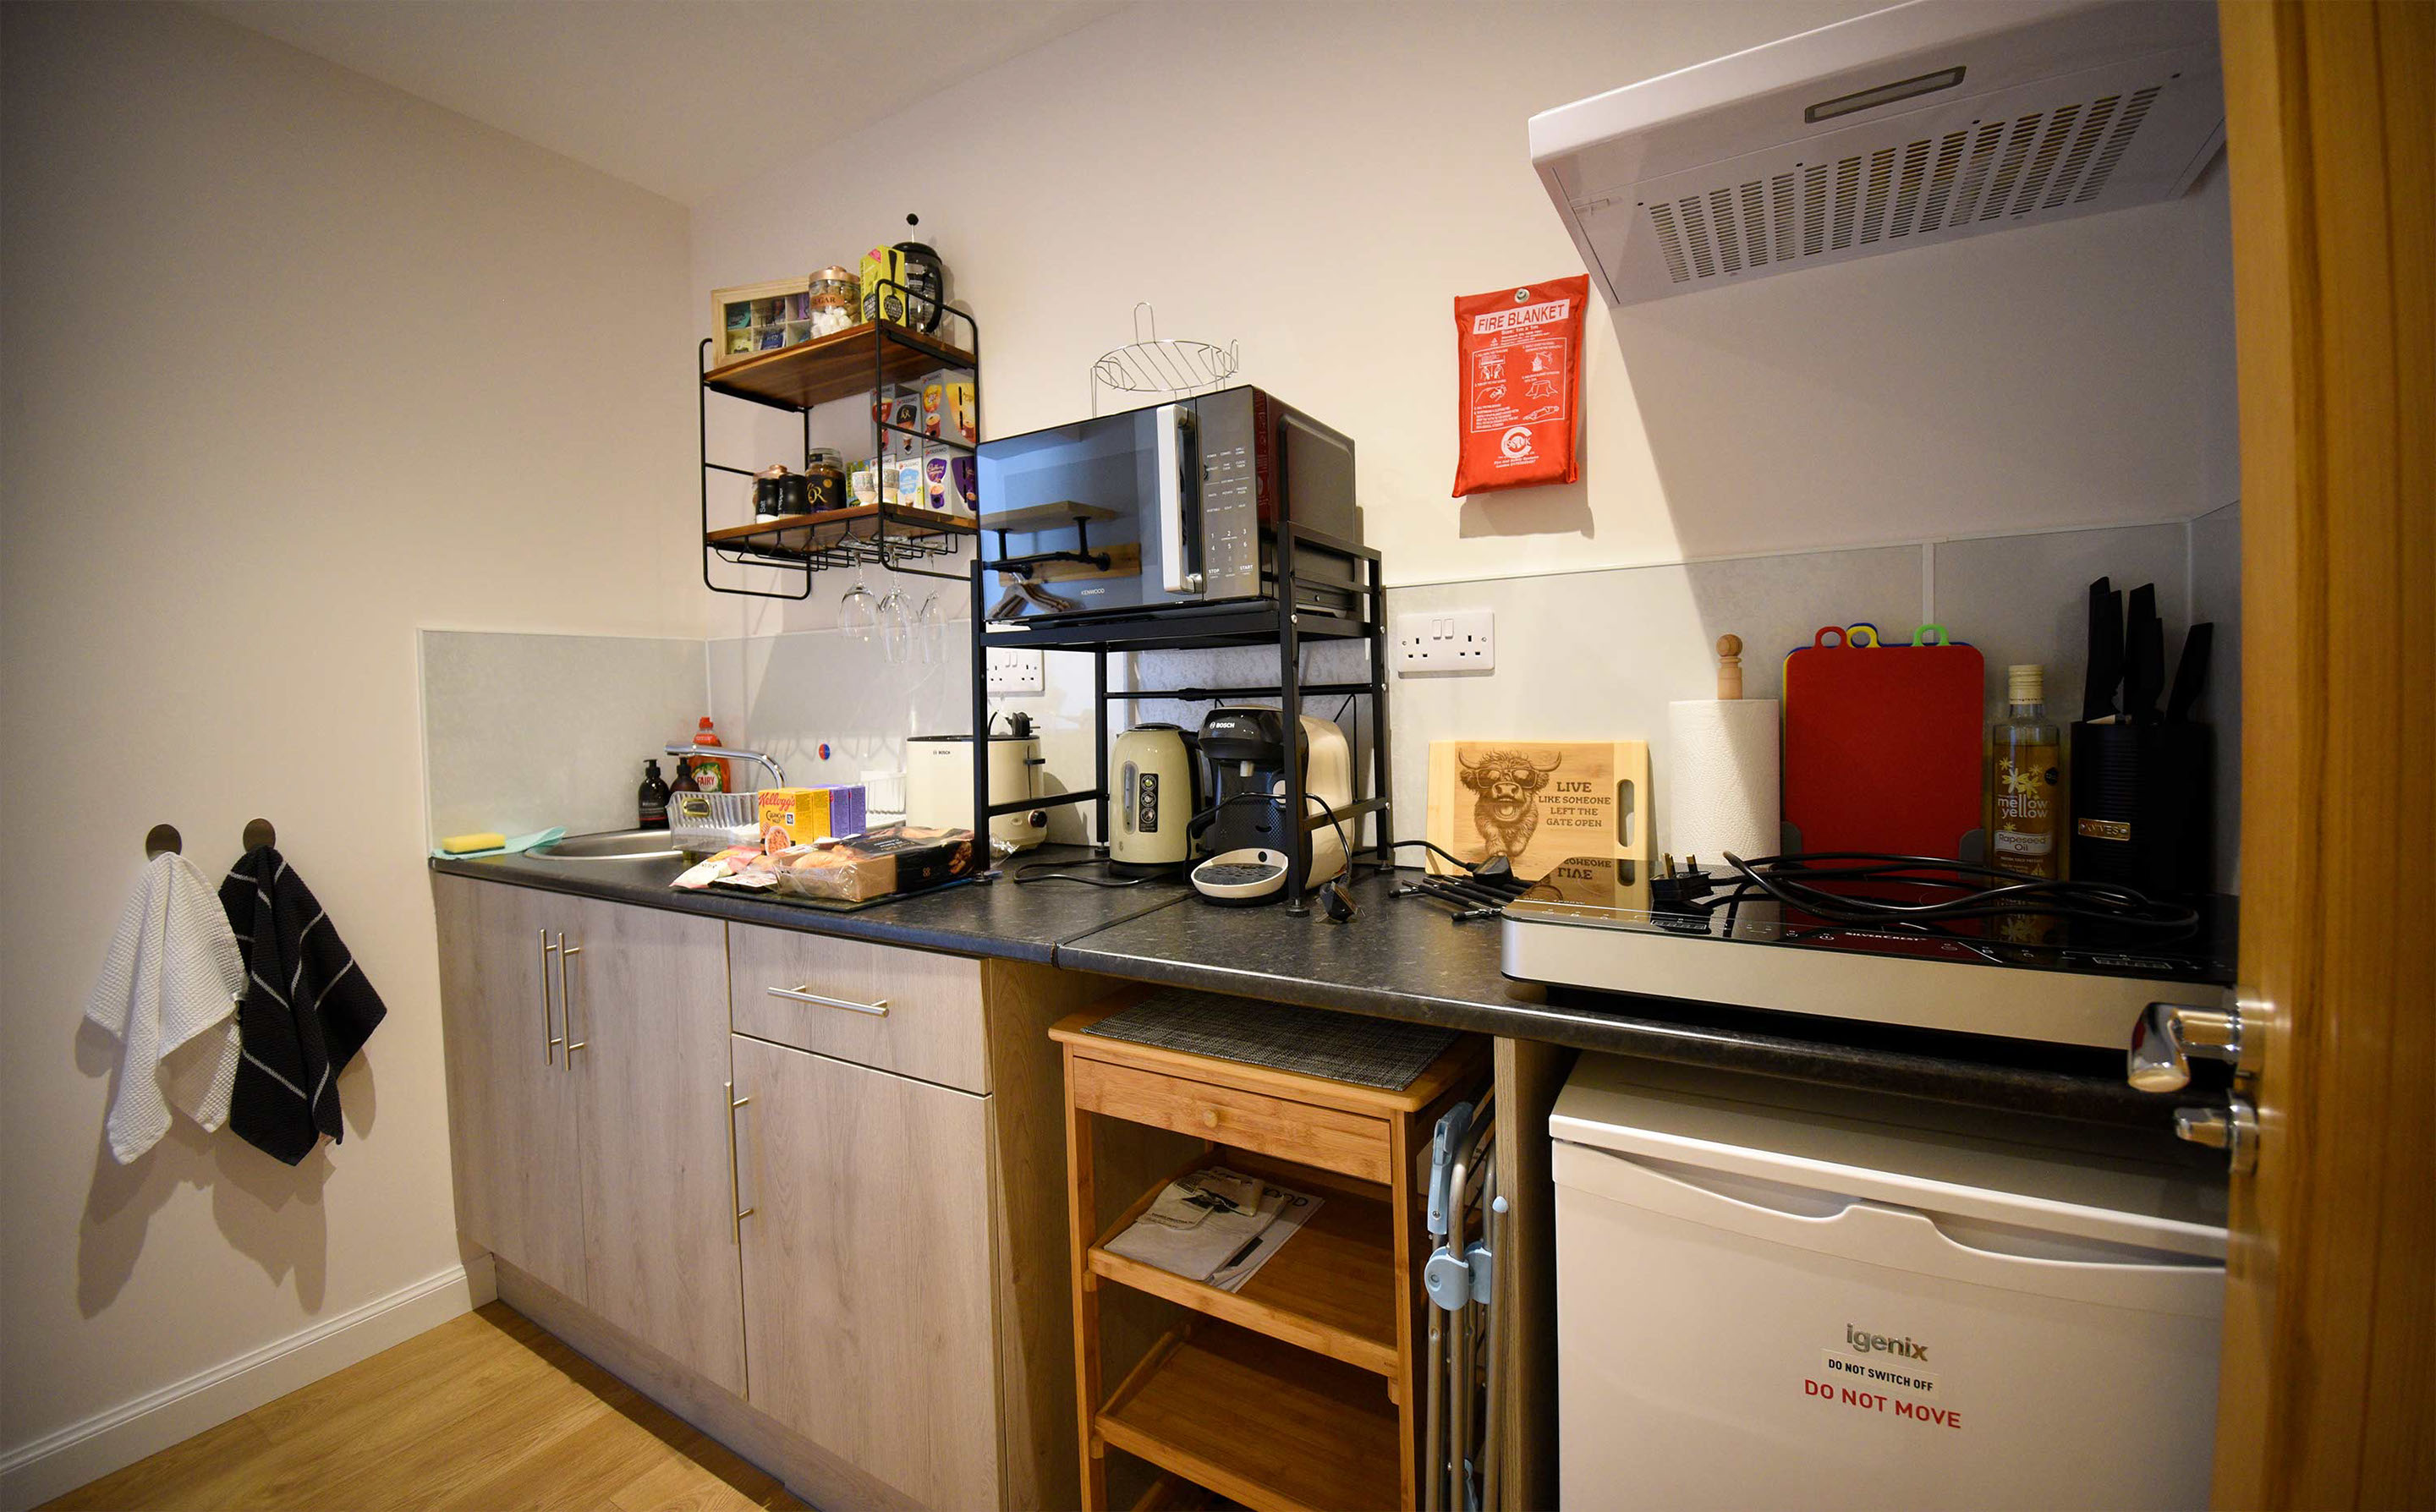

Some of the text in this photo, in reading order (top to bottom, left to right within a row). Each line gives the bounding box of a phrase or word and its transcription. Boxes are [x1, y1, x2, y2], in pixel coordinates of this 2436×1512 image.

[1478, 304, 1565, 331] FIRE BLANKET
[696, 776, 715, 786] FAIRY
[1556, 781, 1592, 792] LIVE
[758, 792, 795, 812] Kellogg's
[1562, 797, 1611, 805] SOMEONE
[1997, 794, 2048, 809] mellow
[1550, 807, 1598, 816] LEFT THE
[2001, 805, 2048, 819] yellow
[1546, 818, 1573, 826] GATE
[1999, 834, 2047, 844] Rapeseed
[2014, 843, 2028, 852] Oil
[1846, 1323, 1928, 1362] igenix
[1829, 1359, 1934, 1391] DO NOT SWITCH OFF
[1804, 1379, 1961, 1429] DO NOT MOVE
